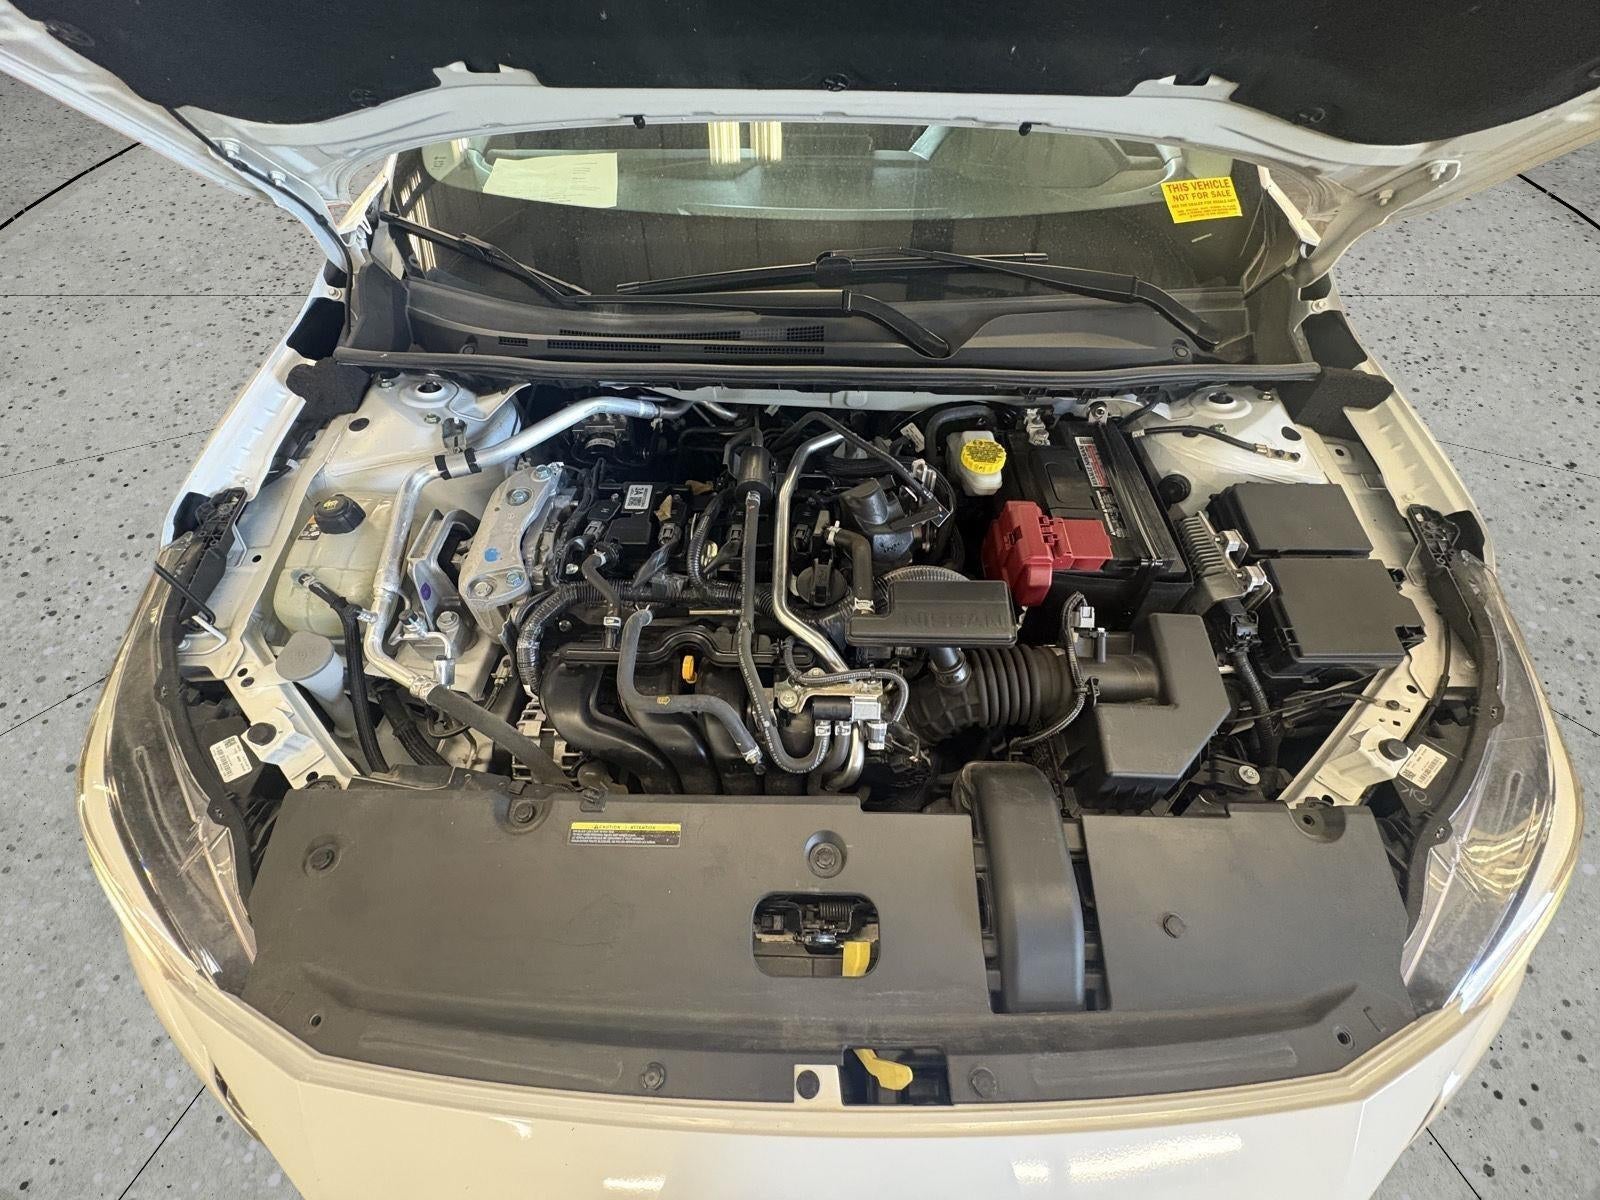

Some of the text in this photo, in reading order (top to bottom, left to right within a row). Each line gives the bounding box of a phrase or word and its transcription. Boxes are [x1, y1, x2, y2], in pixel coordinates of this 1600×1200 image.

[1166, 178, 1231, 194] THIS VEHICLE
[1172, 189, 1232, 202] NOT FOR SALE
